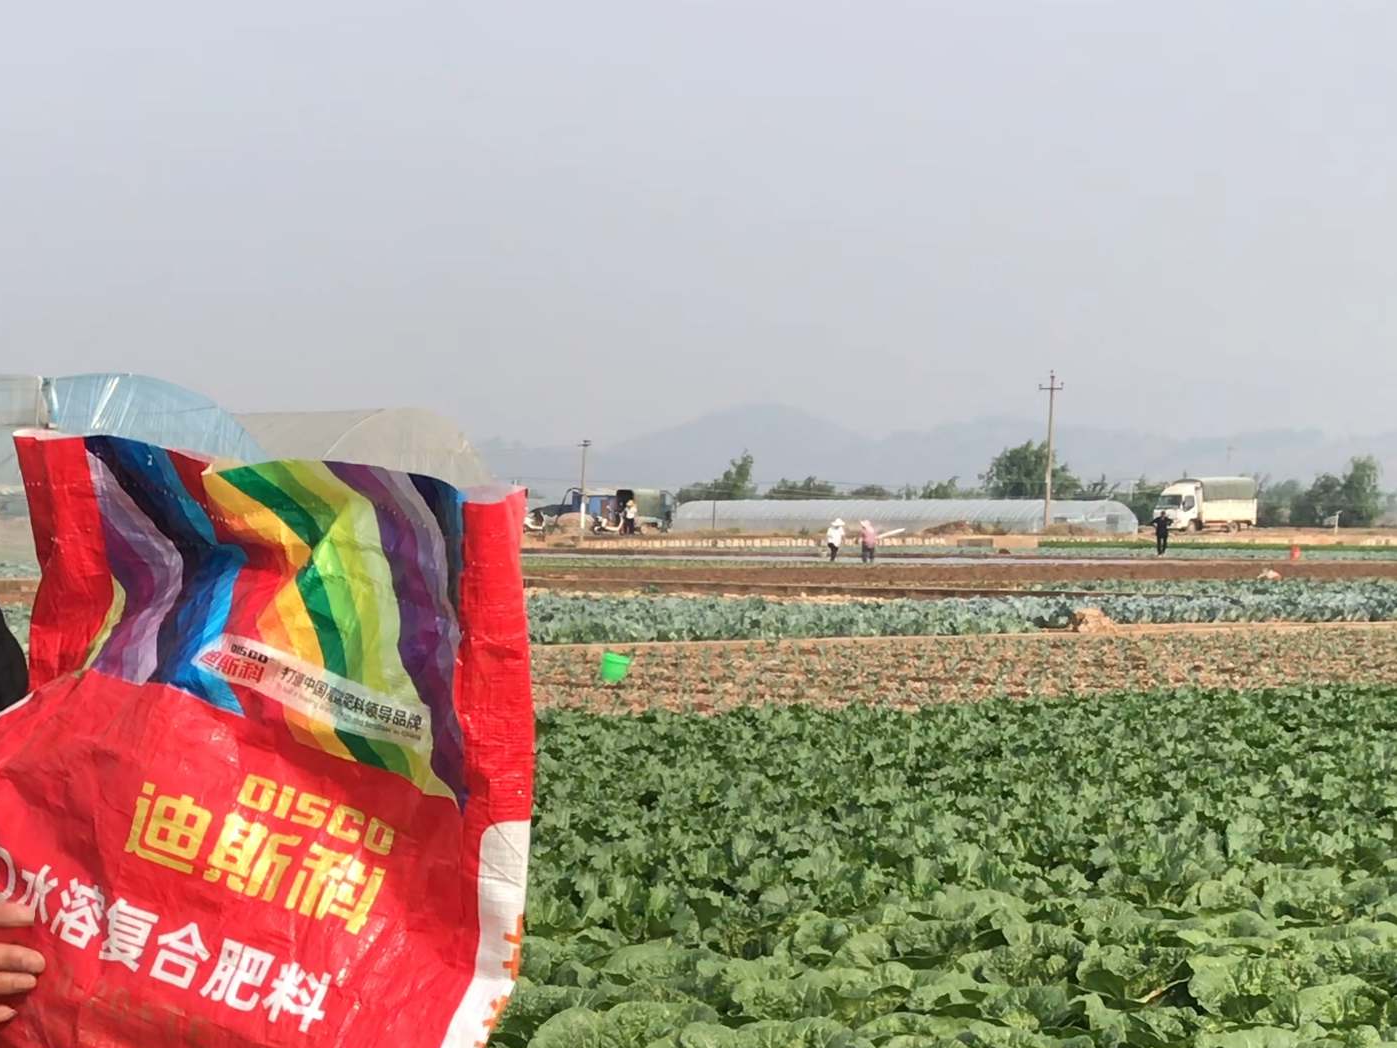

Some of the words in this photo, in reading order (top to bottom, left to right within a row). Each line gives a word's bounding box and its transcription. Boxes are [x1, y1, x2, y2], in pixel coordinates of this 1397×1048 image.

[124, 781, 387, 936] 迪斯科
[237, 773, 395, 856] DISCO
